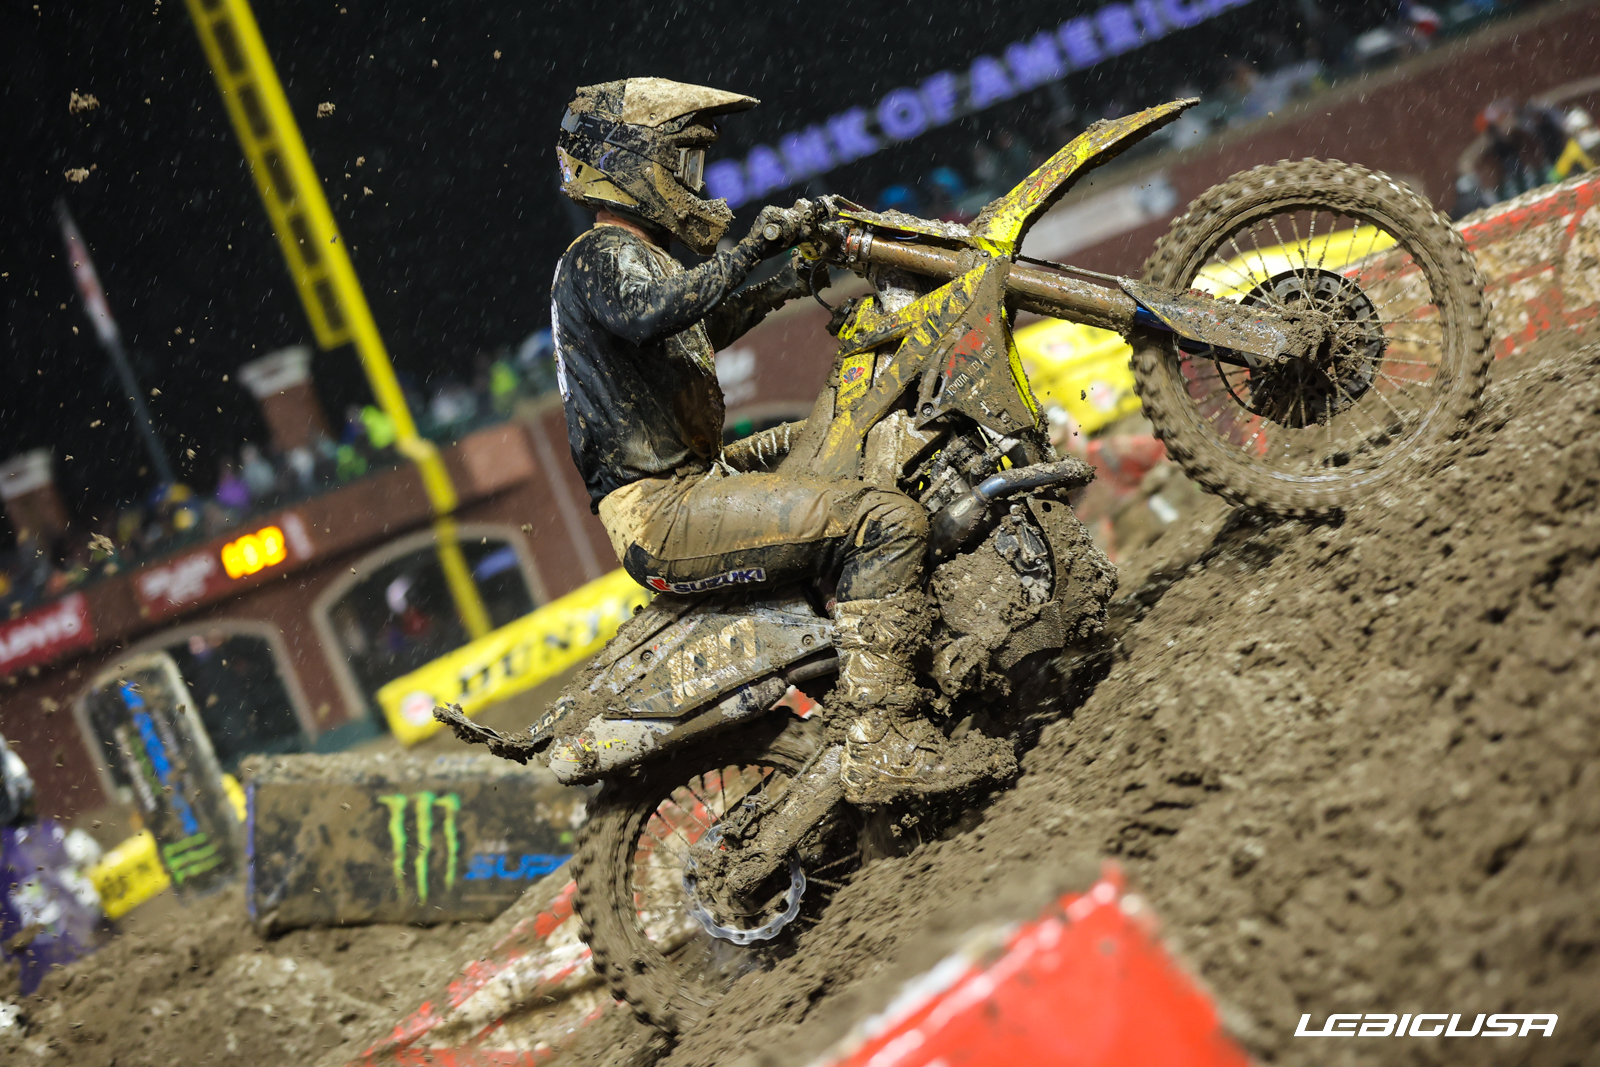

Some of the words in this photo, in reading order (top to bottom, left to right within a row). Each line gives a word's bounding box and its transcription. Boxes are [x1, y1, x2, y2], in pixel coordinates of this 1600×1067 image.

[704, 104, 880, 210] BANK
[878, 69, 957, 141] OF
[968, 0, 1250, 110] AMERIC
[673, 567, 766, 595] SUZUKI
[464, 852, 574, 881] SUP
